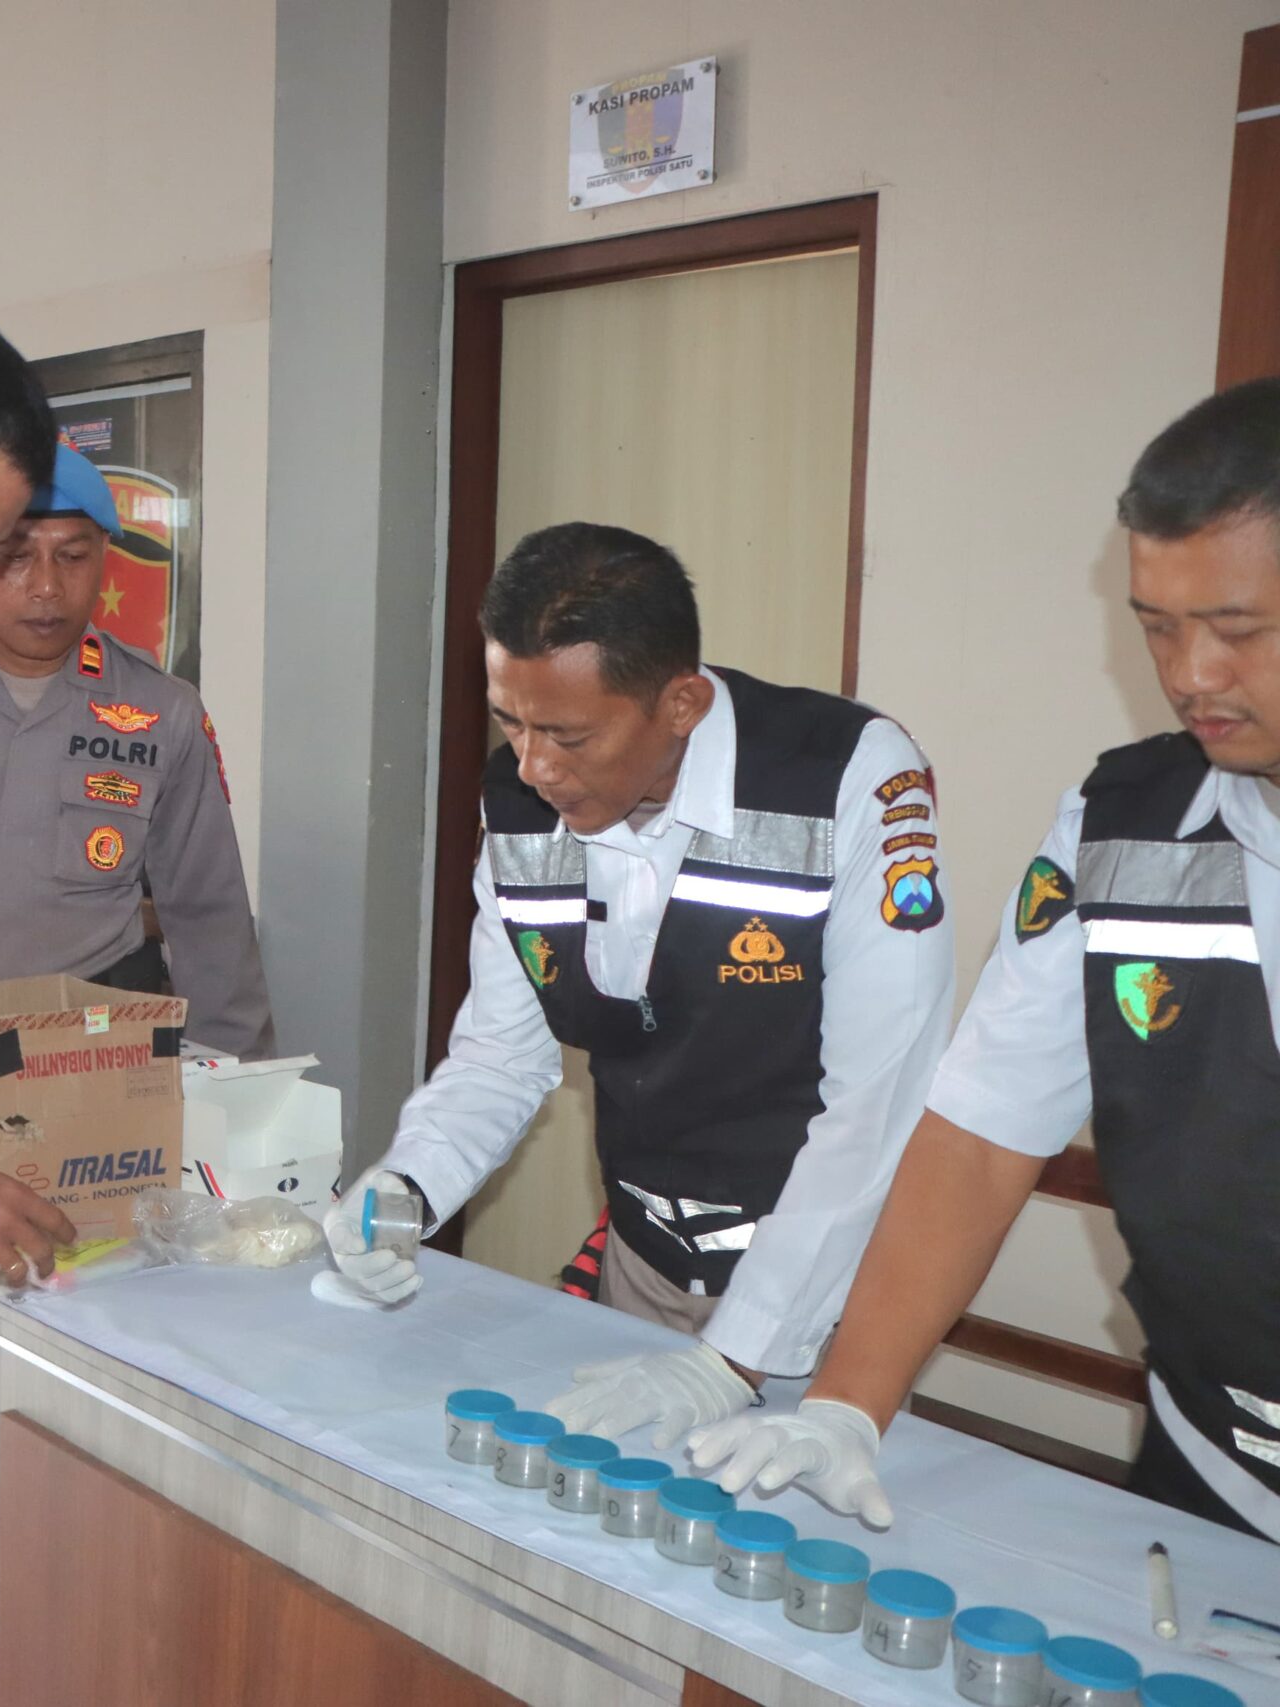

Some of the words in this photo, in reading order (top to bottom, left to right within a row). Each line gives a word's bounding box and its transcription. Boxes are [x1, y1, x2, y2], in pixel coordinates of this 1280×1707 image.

[588, 95, 624, 116] KASI
[629, 77, 695, 106] PROPAM
[669, 159, 693, 172] SATU
[69, 735, 157, 767] POLRI
[718, 964, 805, 984] POLISI
[95, 1043, 151, 1071] JANGAN
[58, 1148, 167, 1188] ITRASAL
[450, 1424, 461, 1448] 7
[496, 1447, 507, 1472] 8
[553, 1472, 566, 1497] 9
